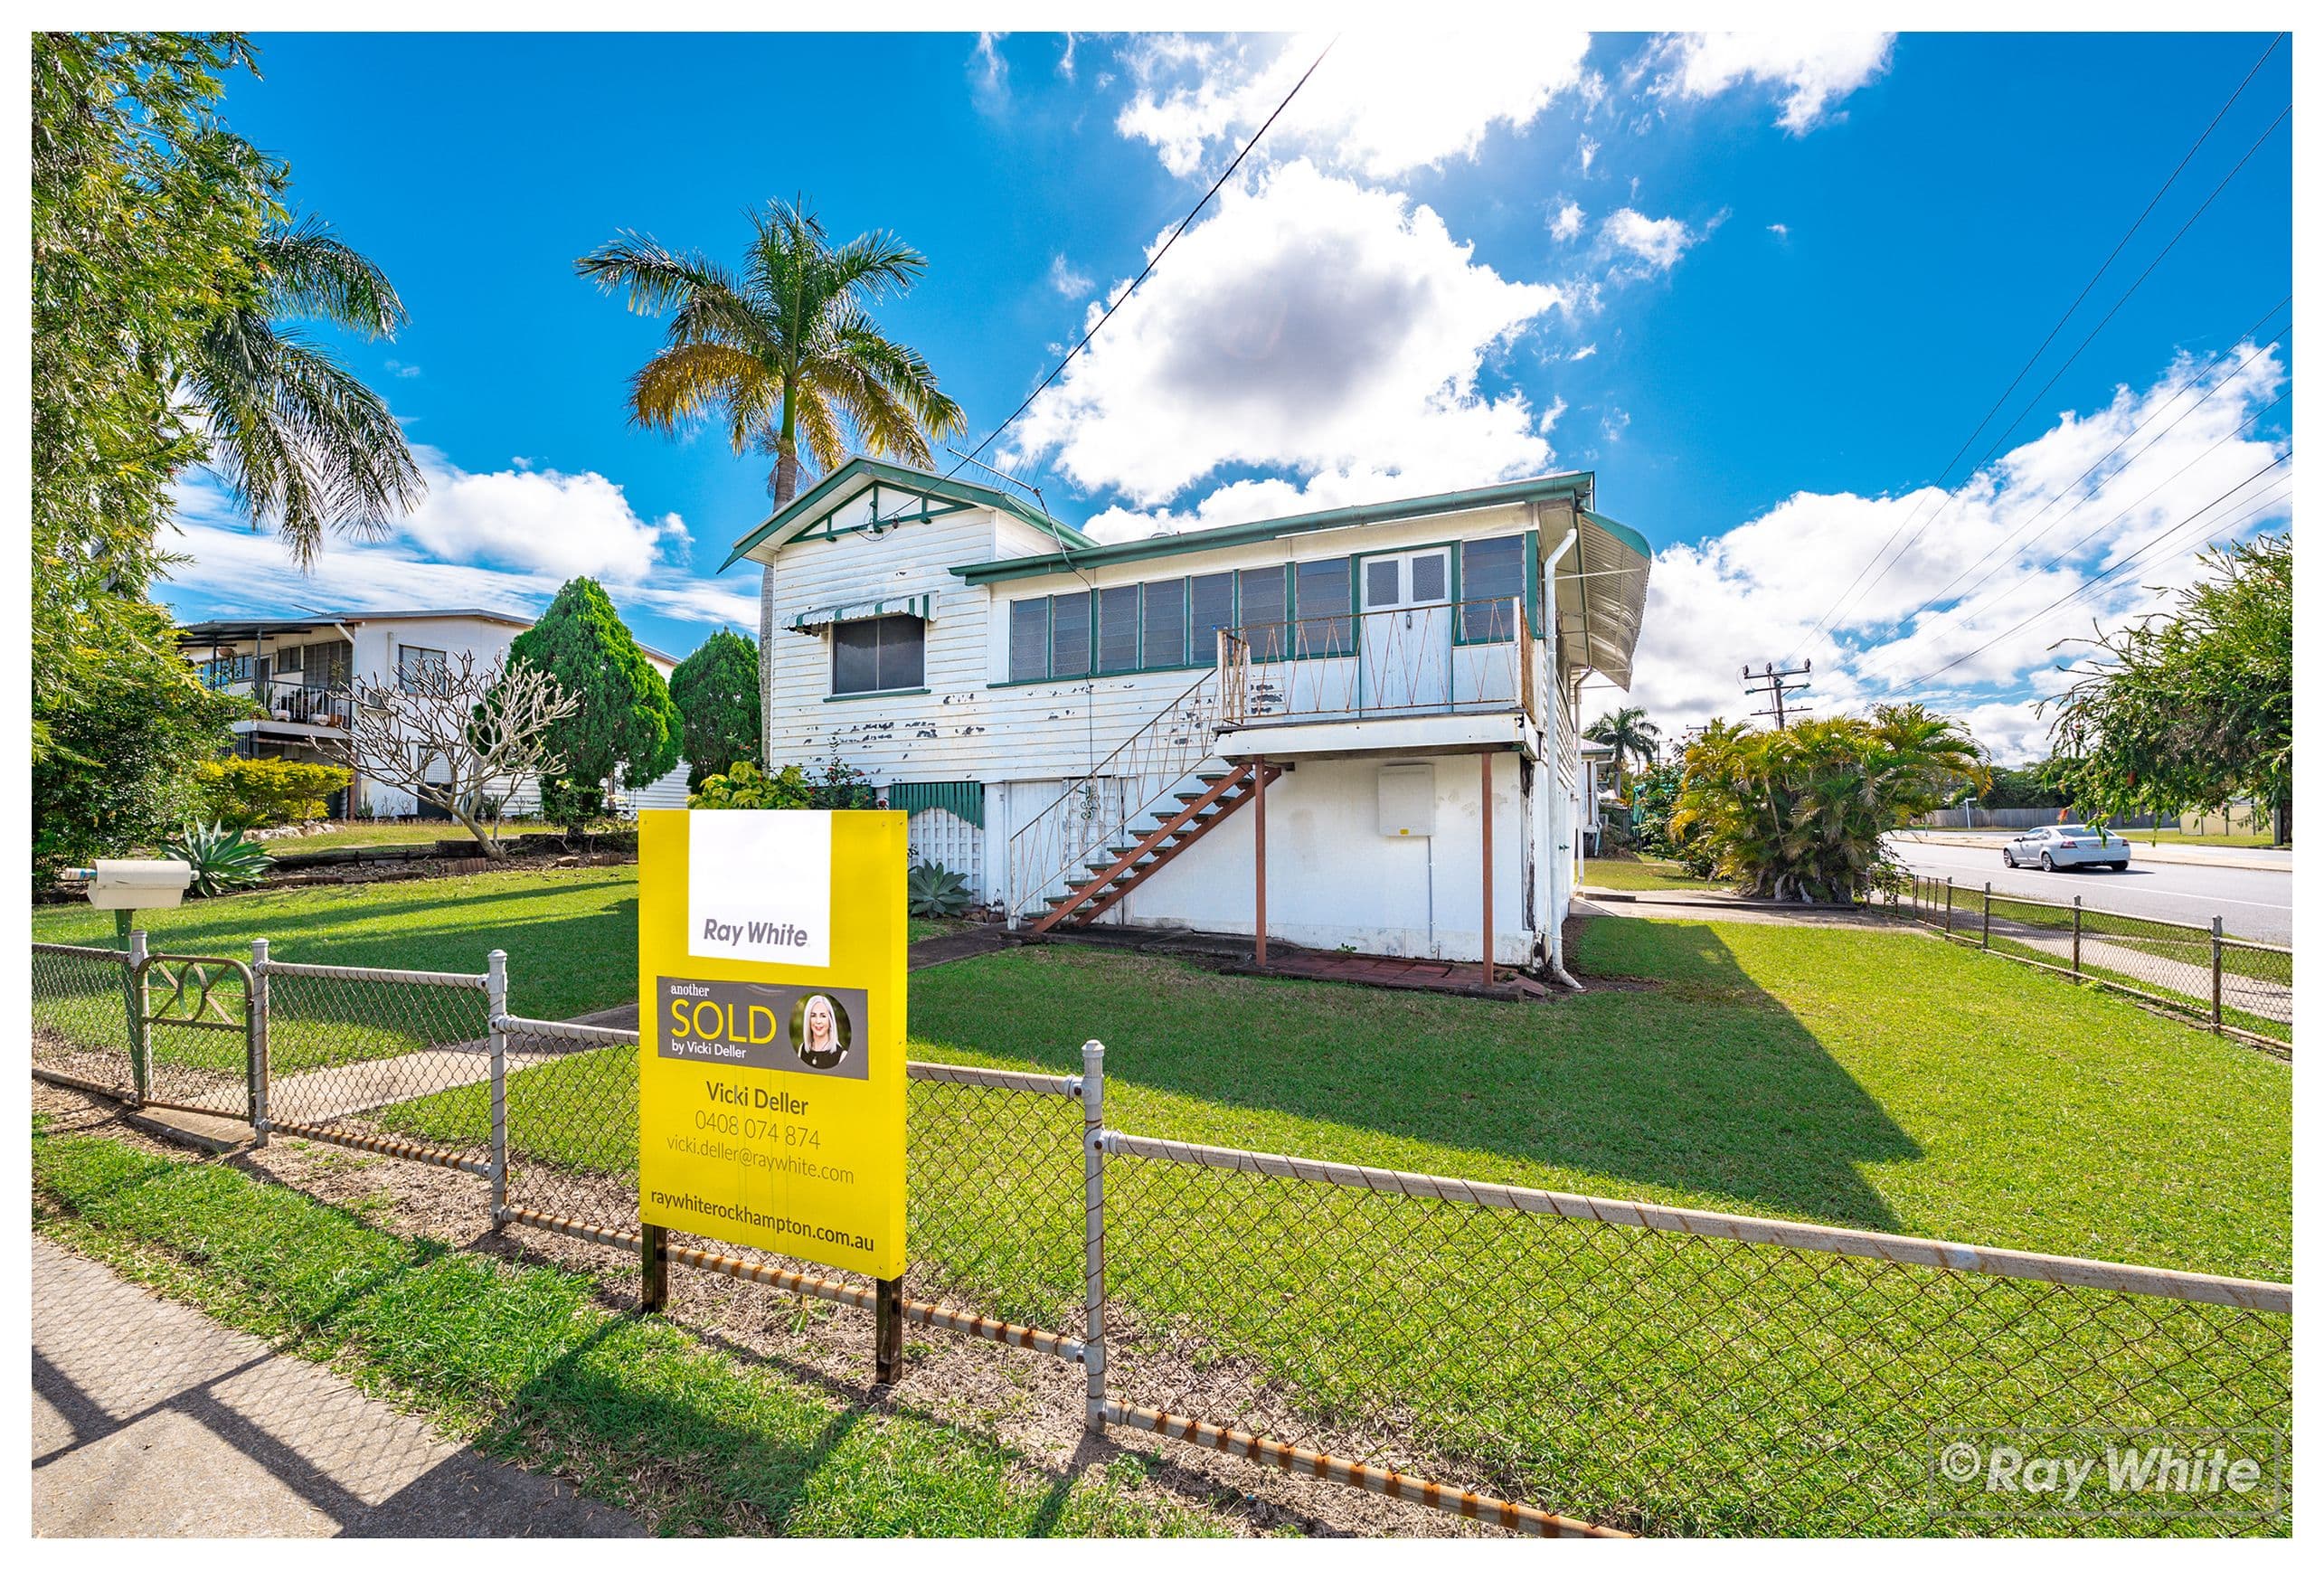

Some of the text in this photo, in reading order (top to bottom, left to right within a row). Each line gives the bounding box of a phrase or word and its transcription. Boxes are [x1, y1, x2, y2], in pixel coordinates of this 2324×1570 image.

[704, 918, 808, 947] Ray White
[671, 984, 710, 998] another
[671, 998, 777, 1045] SOLD
[671, 1039, 747, 1059] by Vicki Deller
[706, 1081, 808, 1116] Vicki Deller
[695, 1110, 821, 1150] 0408 074 874
[666, 1134, 855, 1185] vicki.deller@raywhite.com
[650, 1189, 875, 1253] raywhiterockhampton.com.au
